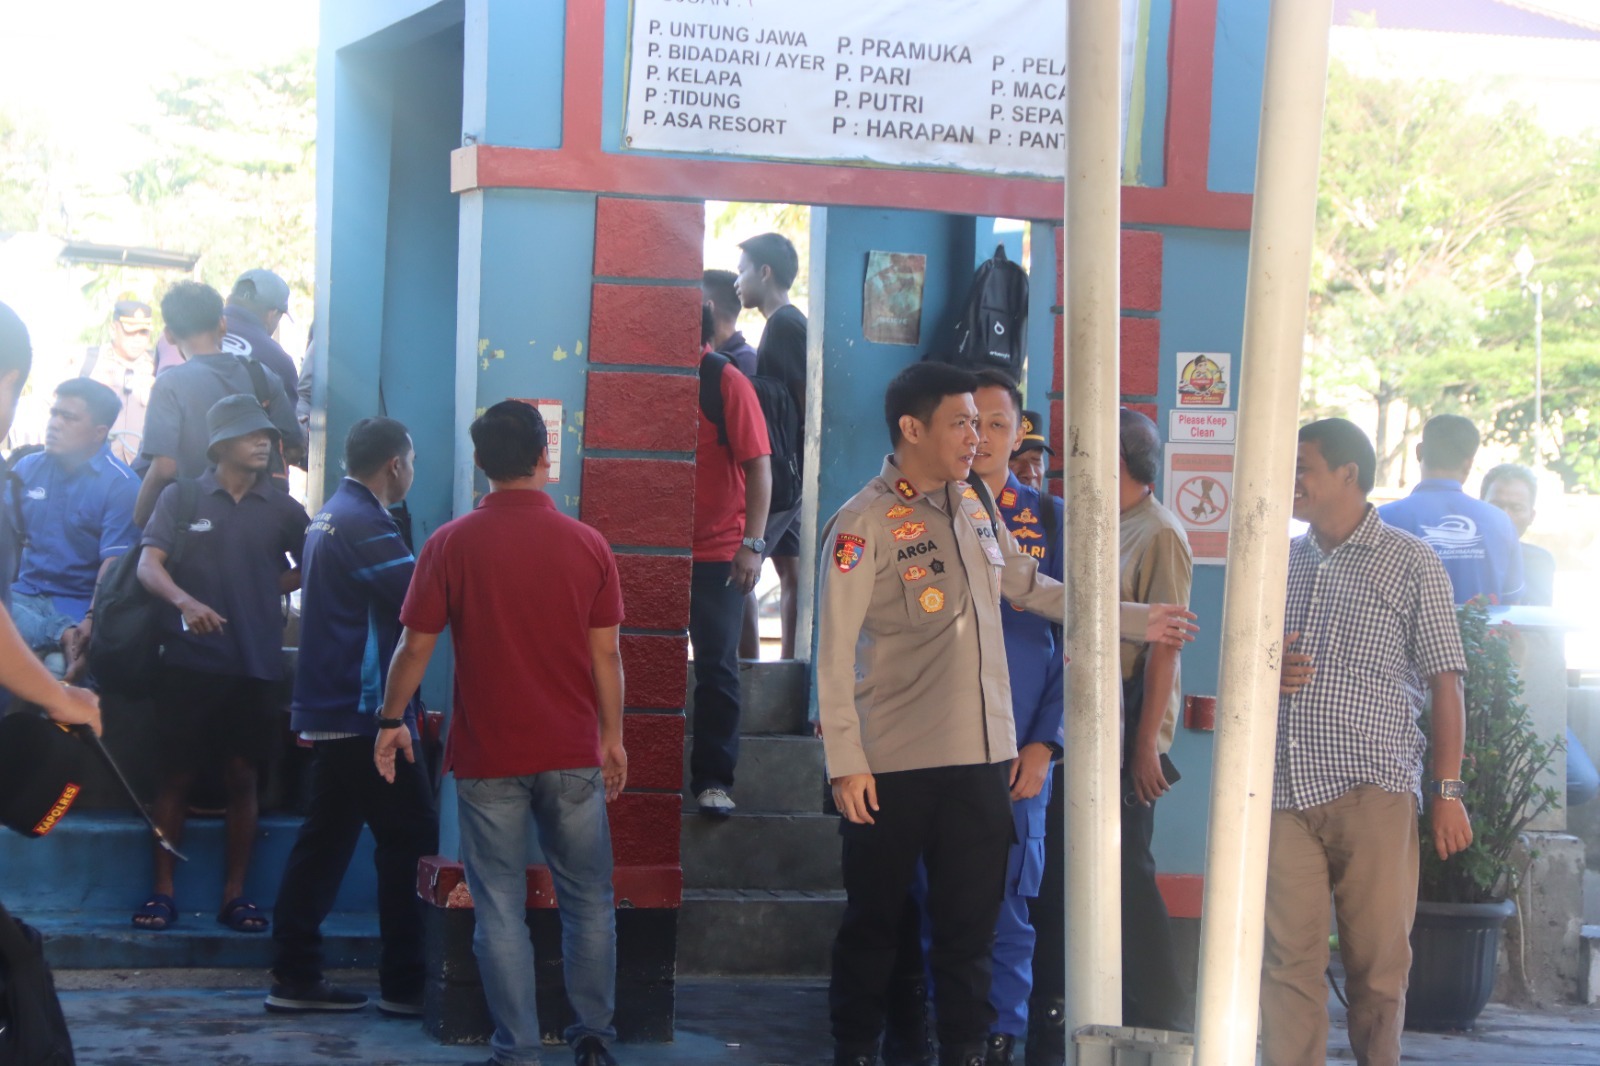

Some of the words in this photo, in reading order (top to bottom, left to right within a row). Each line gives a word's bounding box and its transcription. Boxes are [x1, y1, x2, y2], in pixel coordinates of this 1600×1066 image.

[649, 20, 662, 35] P.
[669, 21, 749, 43] UNTUNG
[755, 29, 808, 47] JAWA
[648, 42, 662, 58] P.
[668, 44, 760, 66] BIDADARI
[775, 53, 825, 71] AYER
[837, 36, 853, 55] P.
[861, 38, 972, 64] PRAMUKA
[647, 65, 660, 81] P.
[667, 67, 742, 87] KELAPA
[835, 63, 852, 82] P.
[860, 65, 911, 86] PARI
[991, 80, 1006, 97] P.
[834, 90, 850, 108] P.
[858, 91, 923, 114] PUTRI
[643, 110, 657, 126] P.
[663, 112, 703, 129] ASA
[708, 115, 787, 134] RESORT
[990, 104, 1005, 121] P.
[1012, 105, 1064, 125] SEPA
[866, 119, 974, 143] HARAPAN
[1179, 414, 1206, 425] Please
[1206, 415, 1227, 427] Keep
[1190, 427, 1215, 438] Clean
[897, 540, 938, 562] ARGA
[36, 786, 76, 833] KAPOLRES
